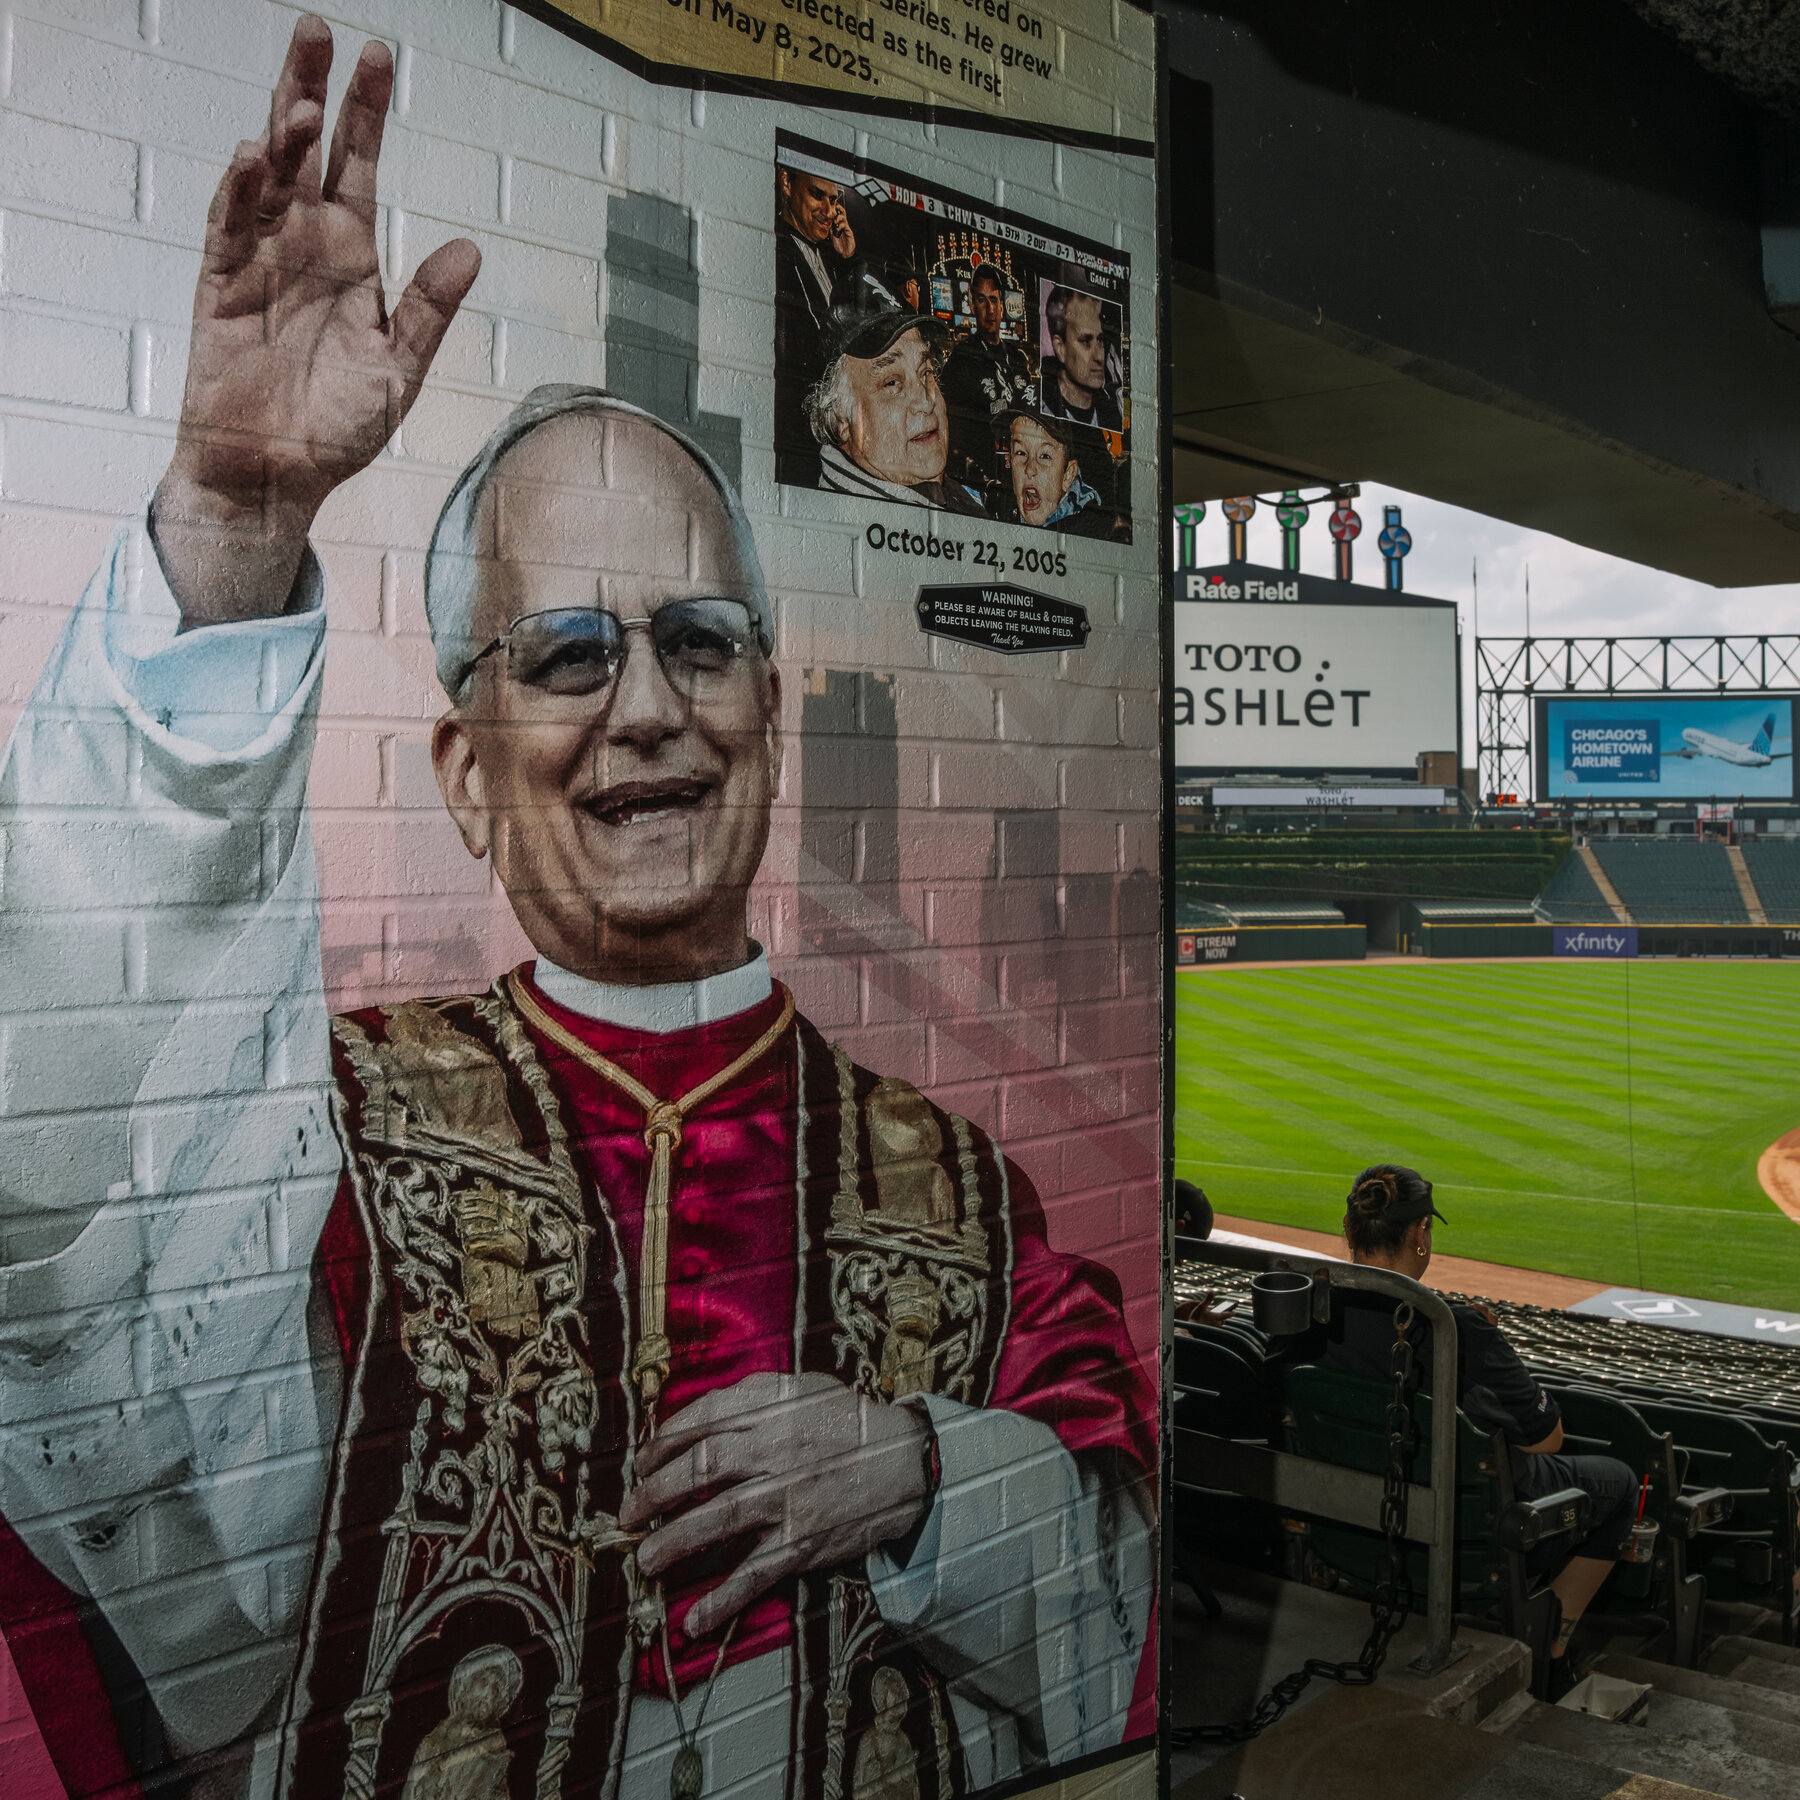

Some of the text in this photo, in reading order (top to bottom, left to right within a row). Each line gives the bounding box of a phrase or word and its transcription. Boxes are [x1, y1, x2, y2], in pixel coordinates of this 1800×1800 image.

[1017, 14, 1042, 39] on
[712, 0, 767, 43] May
[775, 23, 798, 58] 8,
[808, 35, 879, 85] 2025.
[965, 21, 993, 54] He
[1001, 43, 1052, 79] grew
[883, 31, 908, 56] as
[916, 40, 952, 75] the
[960, 57, 1001, 97] first
[928, 199, 935, 212] 3
[948, 204, 972, 226] CHW
[980, 217, 986, 230] 5
[1027, 235, 1032, 246] 2
[1090, 271, 1117, 291] GAME 1
[866, 523, 1067, 577] October 22, 2005
[982, 590, 1033, 607] WARNING!
[1187, 575, 1299, 601] Rate Field
[935, 601, 1074, 625] PLEASE BE AWARE OF BALLS & OTHER
[935, 615, 1073, 637] OBJECTS LEAVING THE PLAYING FIELD.
[1185, 644, 1302, 672] TOTO
[1571, 729, 1647, 741] CHICAGO'S
[1571, 743, 1653, 754] HOMETOWN
[1572, 756, 1622, 768] AIRLINE
[1178, 796, 1204, 806] DECK
[1196, 936, 1236, 949] STREAM
[1565, 932, 1627, 953] xfinity
[1205, 948, 1228, 960] NOW
[1563, 1508, 1576, 1522] 35
